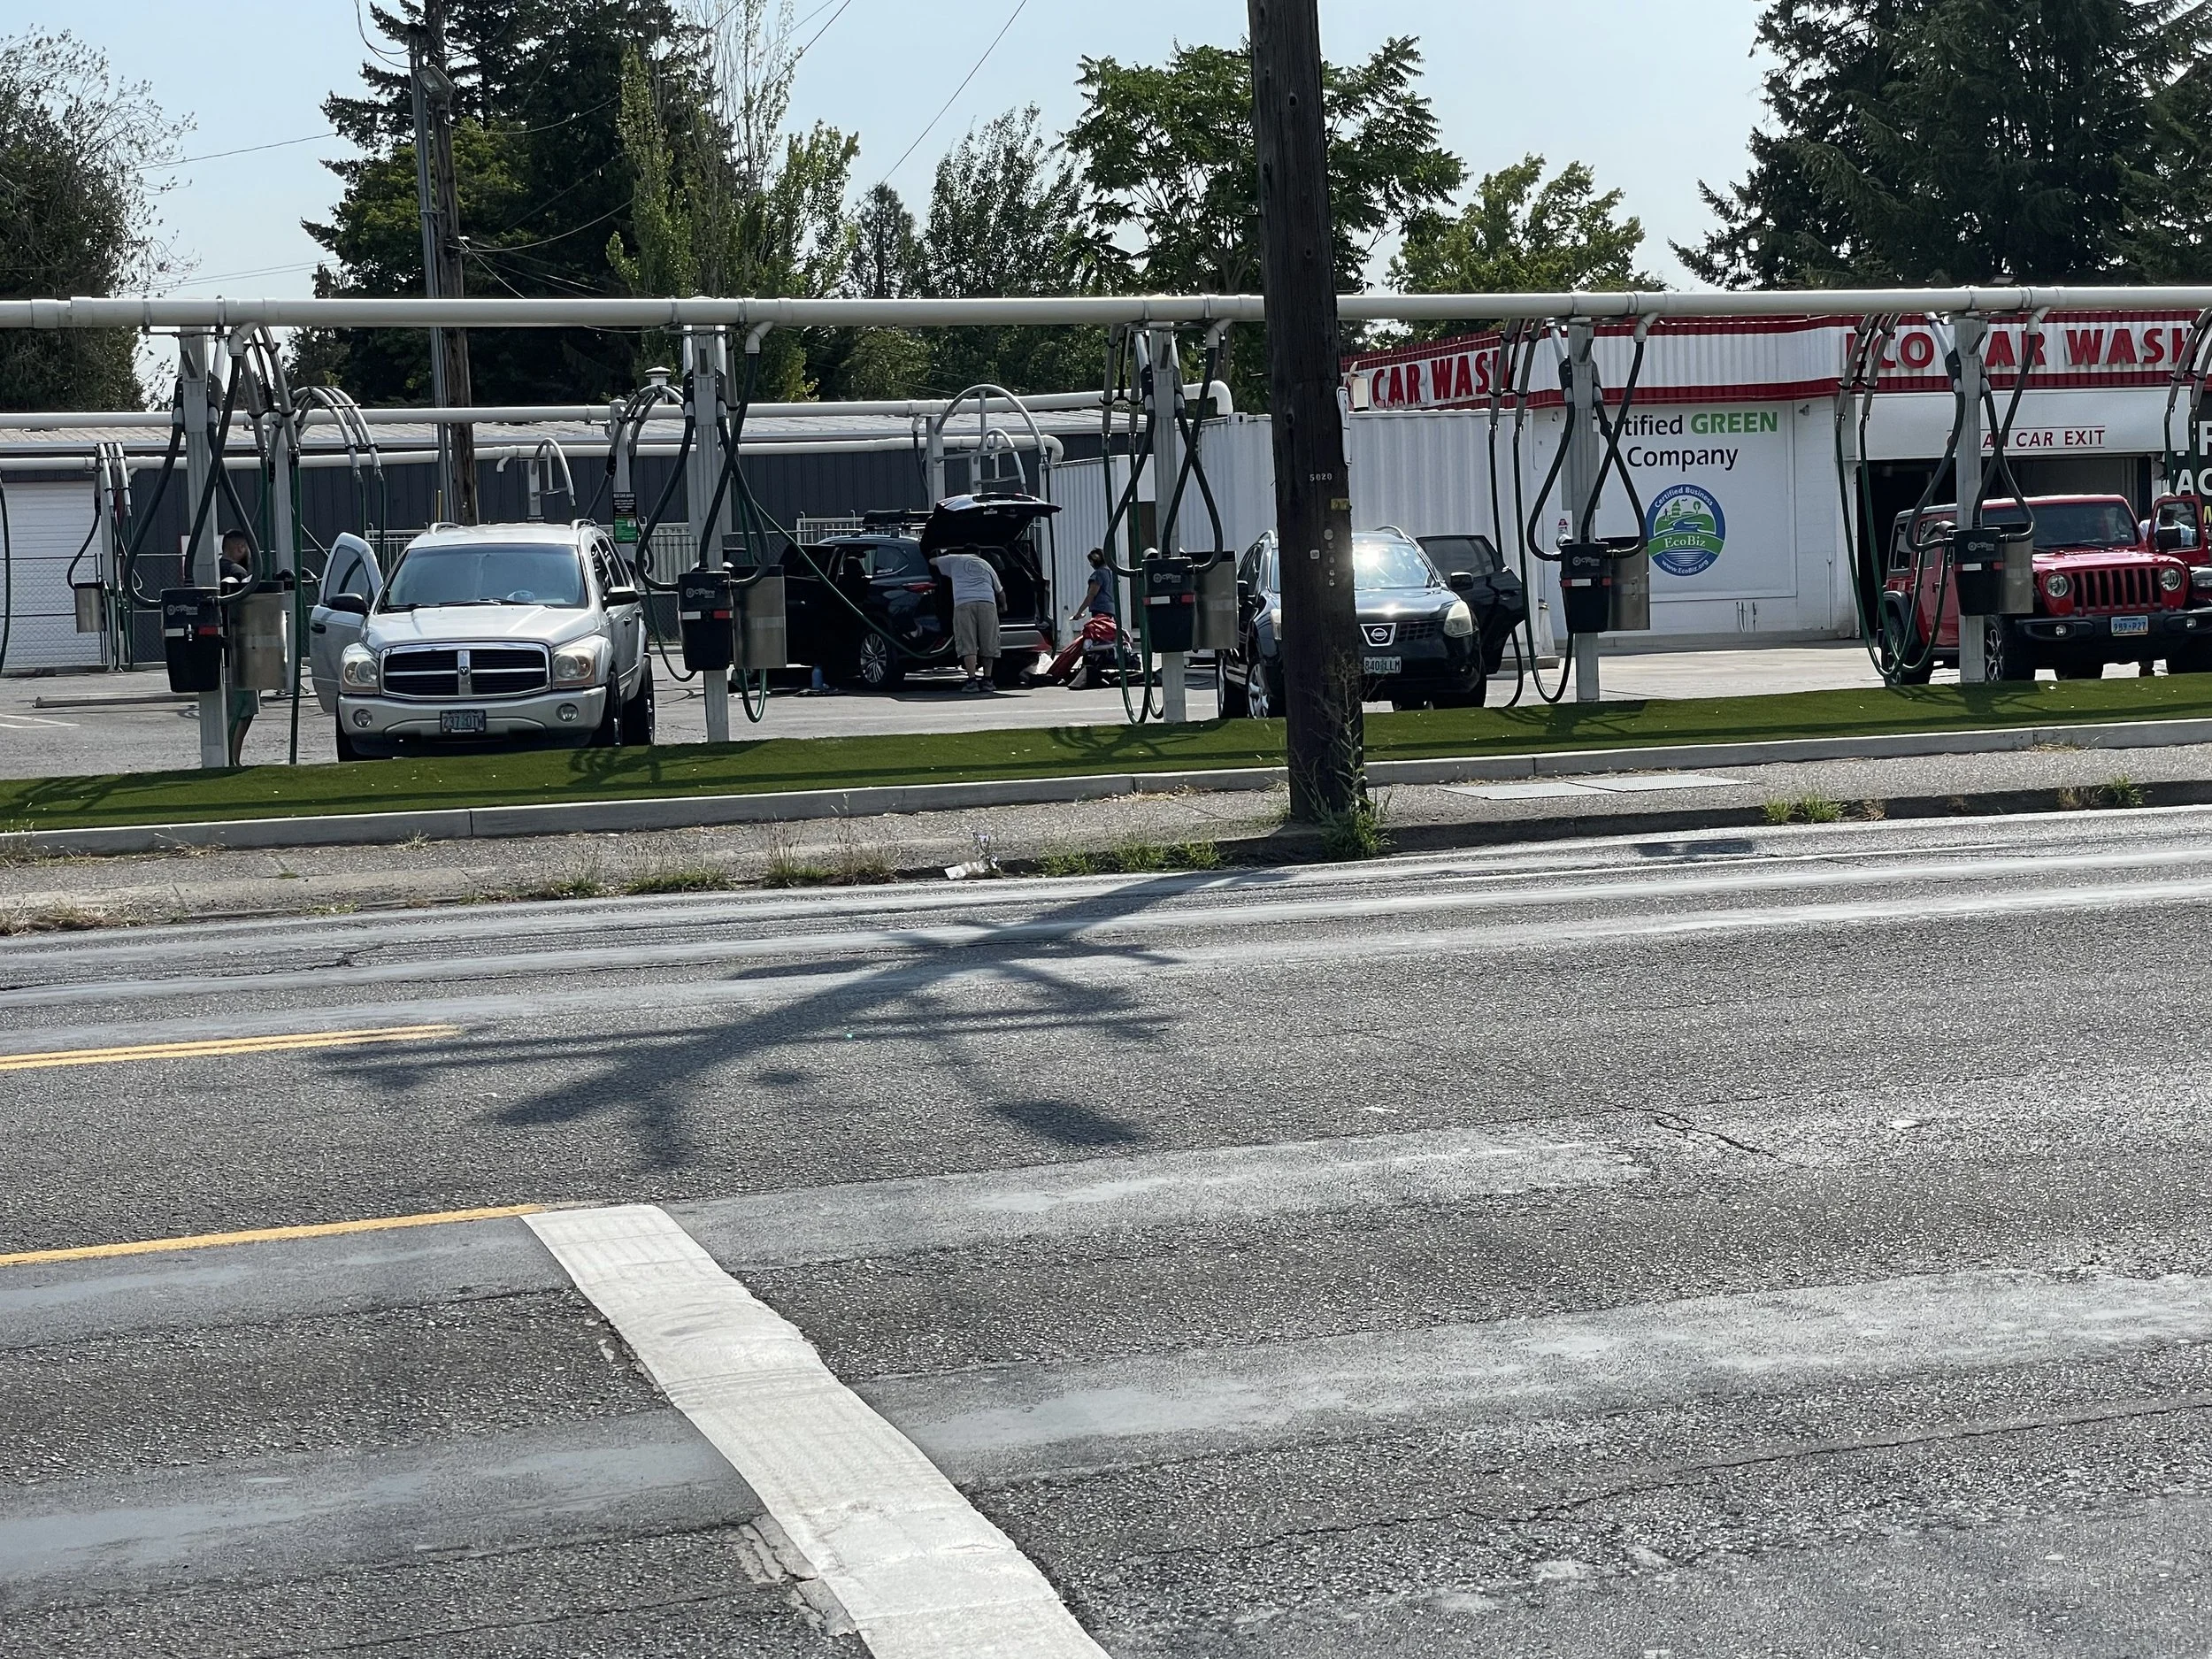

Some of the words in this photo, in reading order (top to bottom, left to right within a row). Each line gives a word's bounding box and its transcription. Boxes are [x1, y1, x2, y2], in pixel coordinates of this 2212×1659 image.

[1985, 330, 2047, 367] AR
[1372, 364, 1423, 408] CAR
[1593, 414, 1684, 436] tified
[1690, 411, 1778, 434] GREEN
[2016, 432, 2054, 447] CAR
[2064, 430, 2106, 446] EXIT
[1626, 446, 1739, 472] Company
[1310, 472, 1333, 482] 5020
[1655, 487, 1683, 508] Certified
[1685, 487, 1713, 506] Business
[1664, 535, 1706, 548] EcoBiz
[1662, 559, 1709, 574] www.EcoBiz.org
